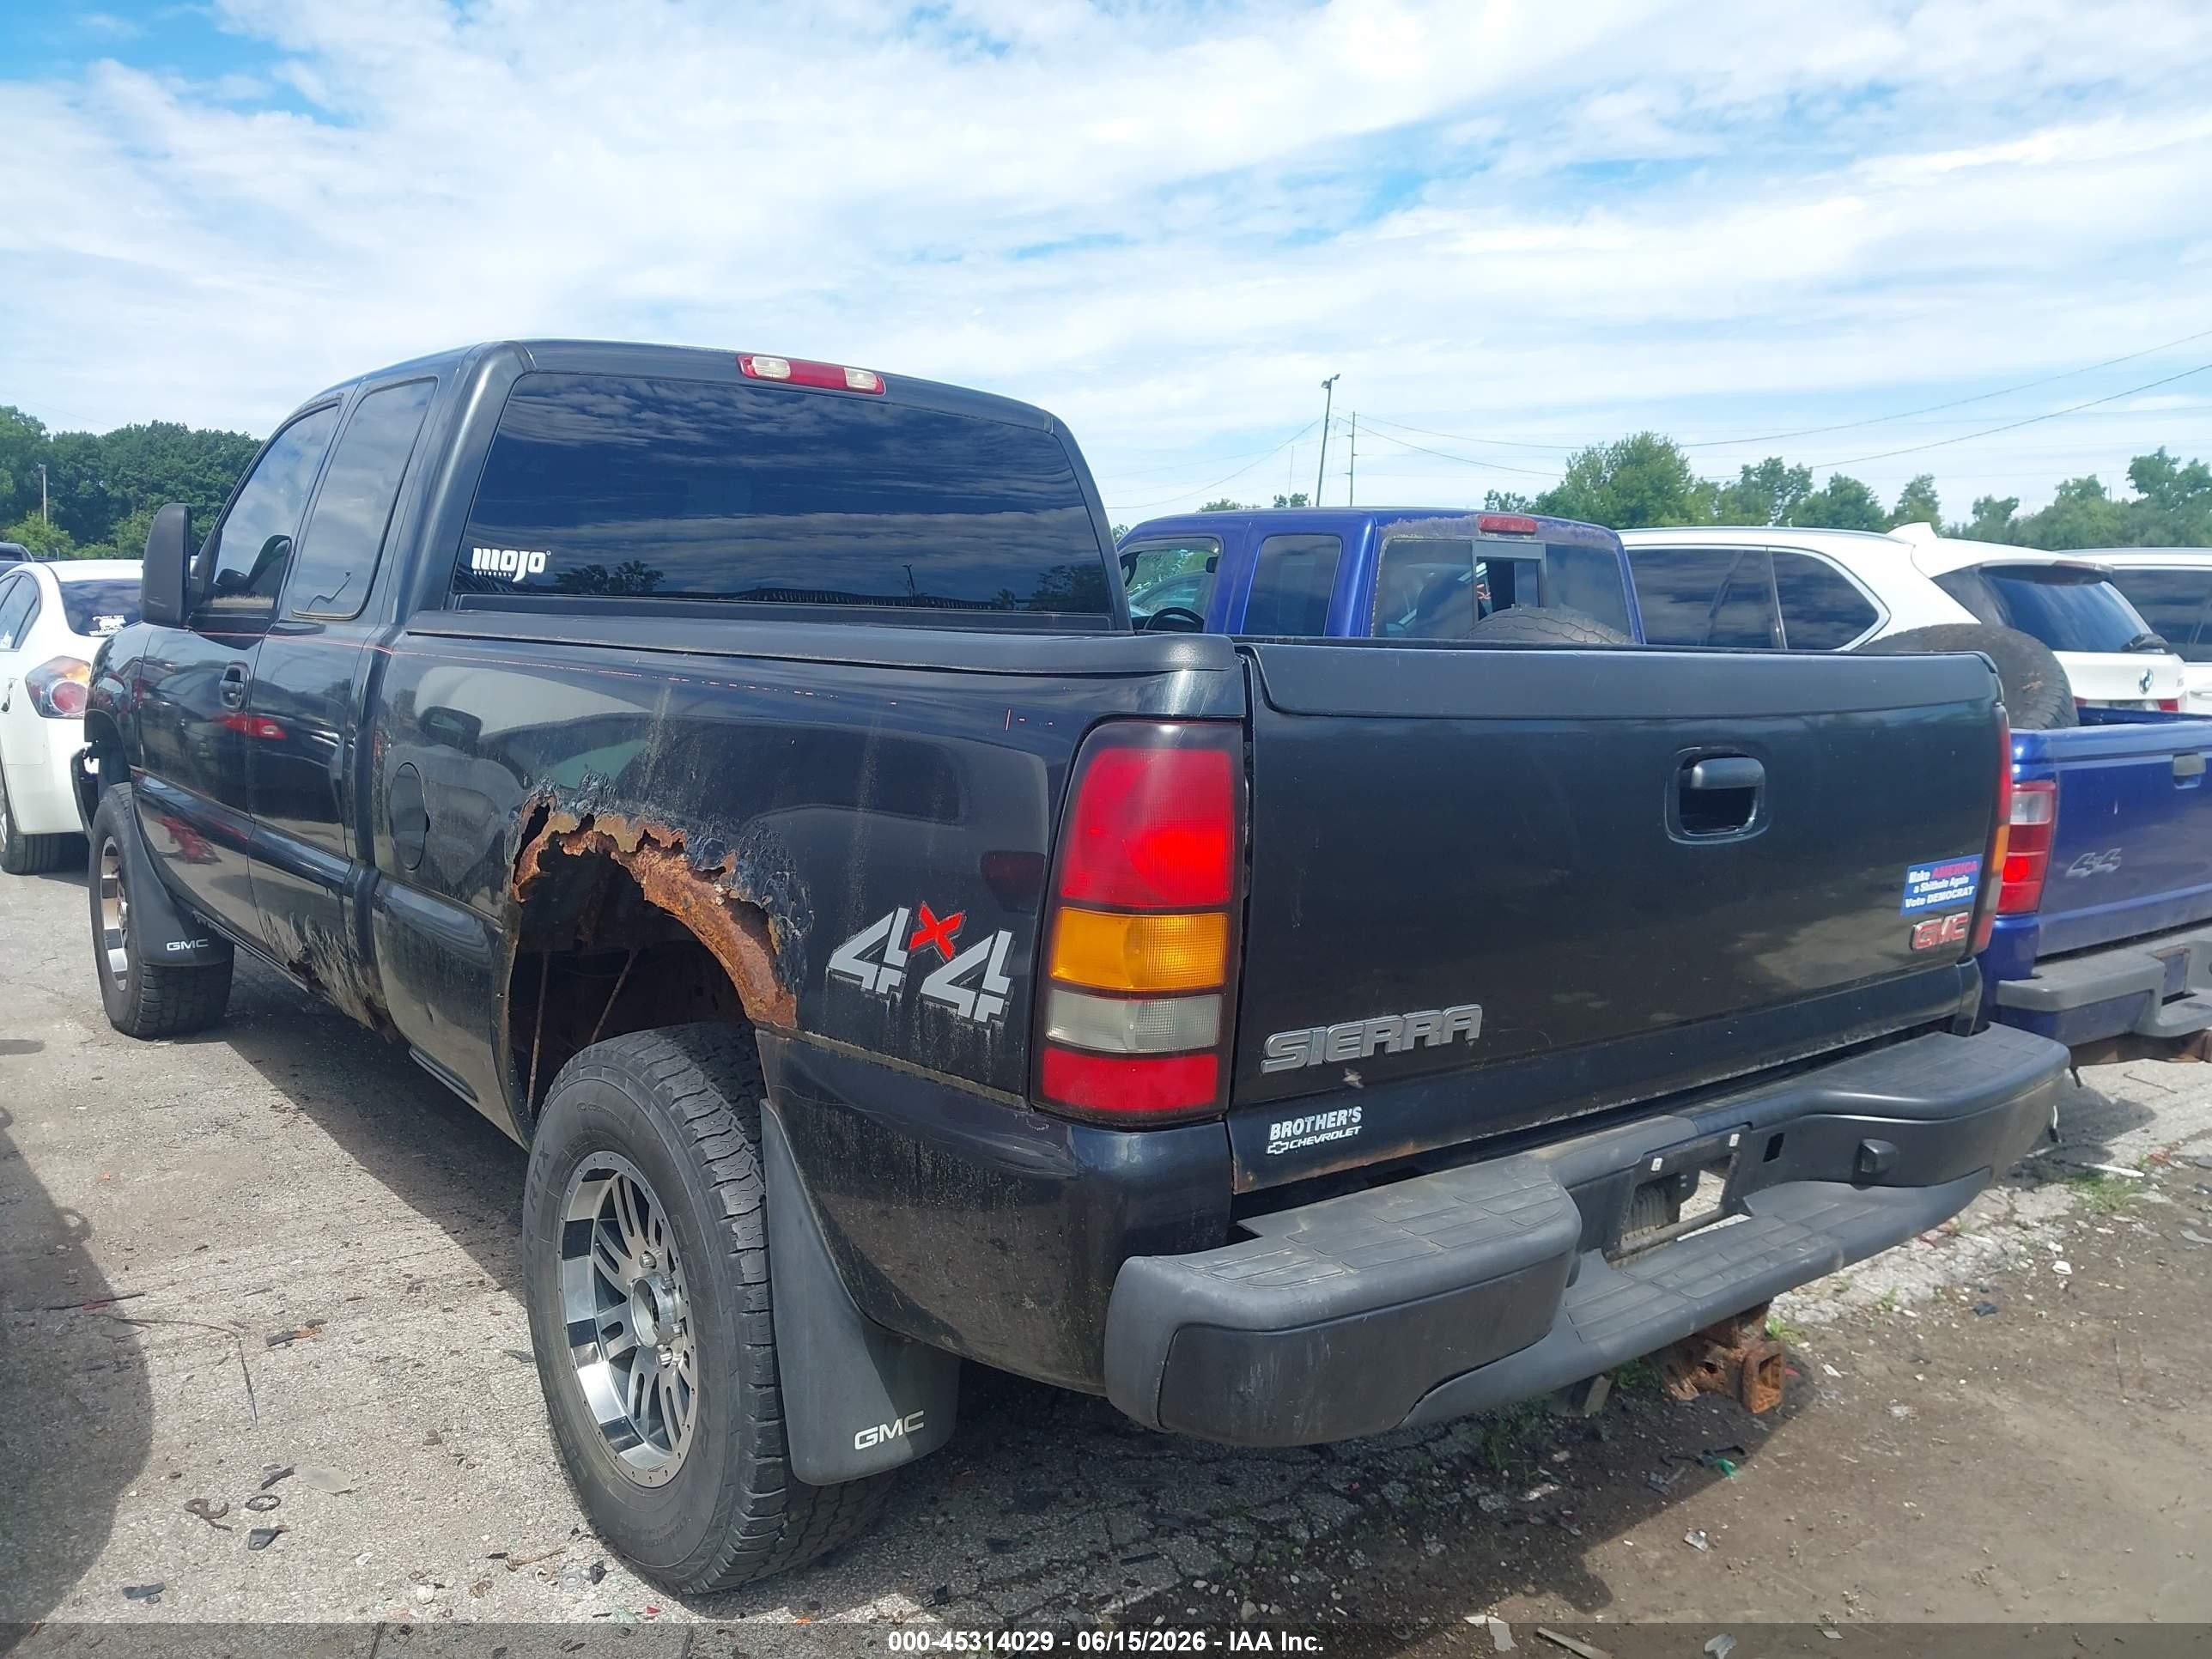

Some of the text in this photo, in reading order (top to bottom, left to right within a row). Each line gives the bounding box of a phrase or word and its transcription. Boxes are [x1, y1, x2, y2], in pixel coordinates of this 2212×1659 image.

[471, 547, 546, 583] mojo
[1908, 860, 1978, 884] Make AMERICA
[1905, 885, 1975, 908] Vote DEMOCRAT
[166, 938, 209, 951] GMC
[1911, 912, 1969, 950] GMC
[1260, 1003, 1482, 1074] SIERRA
[1269, 1105, 1363, 1141] BROTHER'S
[1288, 1125, 1363, 1150] CHEVROLET
[854, 1409, 925, 1450] GMC
